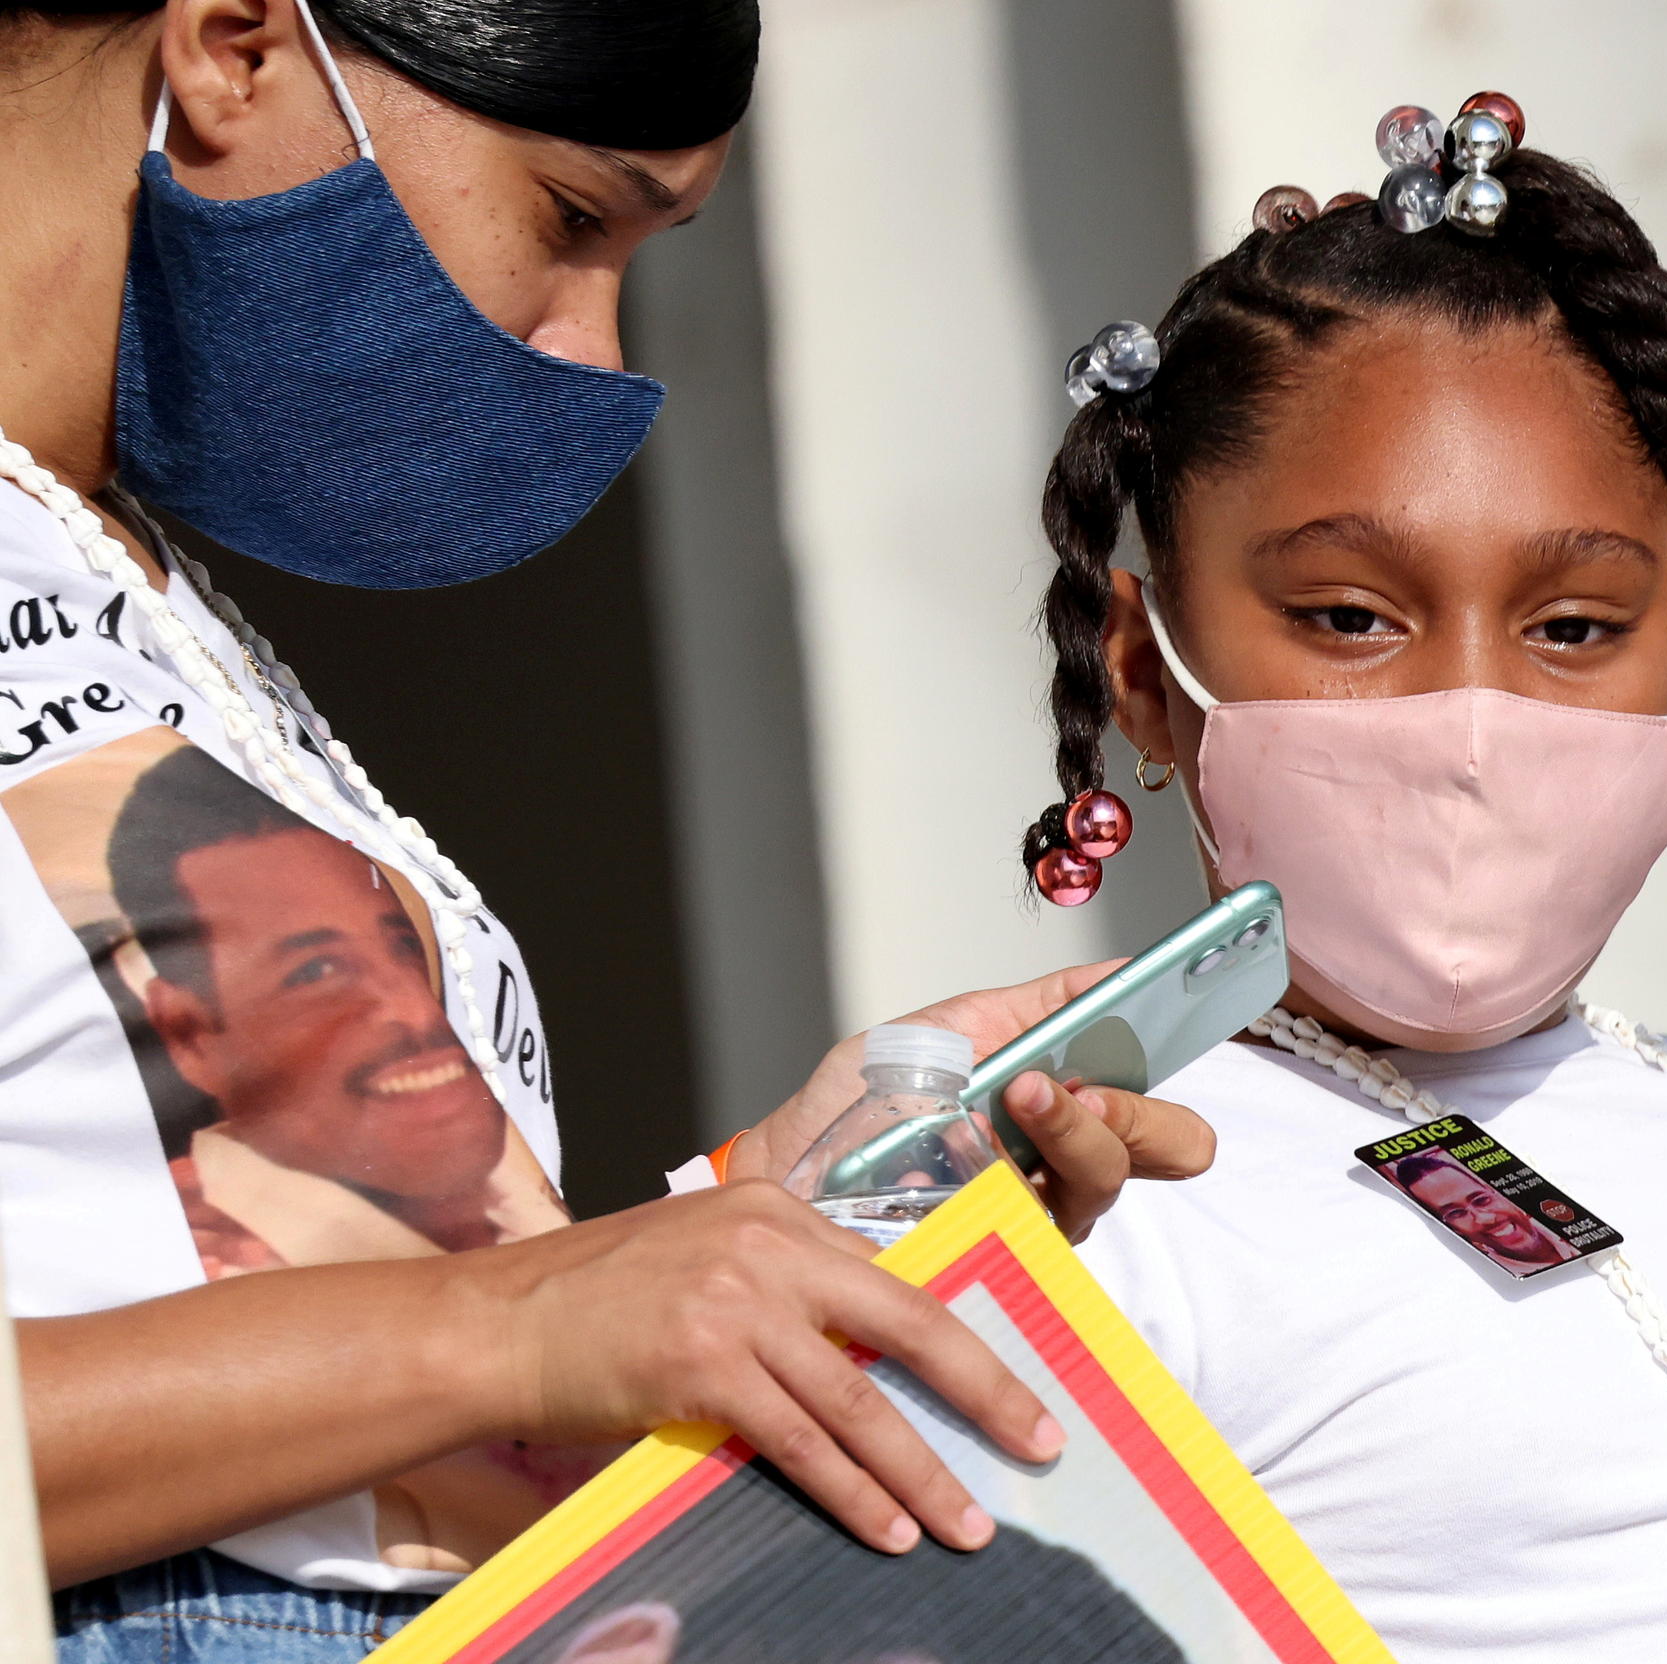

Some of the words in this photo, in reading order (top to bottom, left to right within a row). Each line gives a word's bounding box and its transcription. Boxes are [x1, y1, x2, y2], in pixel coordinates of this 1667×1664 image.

[1374, 1118, 1463, 1160] JUSTICE
[1450, 1136, 1495, 1159] RONALD
[1467, 1149, 1511, 1172] GREENE
[1545, 1204, 1568, 1218] STOP
[1562, 1217, 1598, 1237] POLICE
[1569, 1225, 1617, 1249] BRUTALITY
